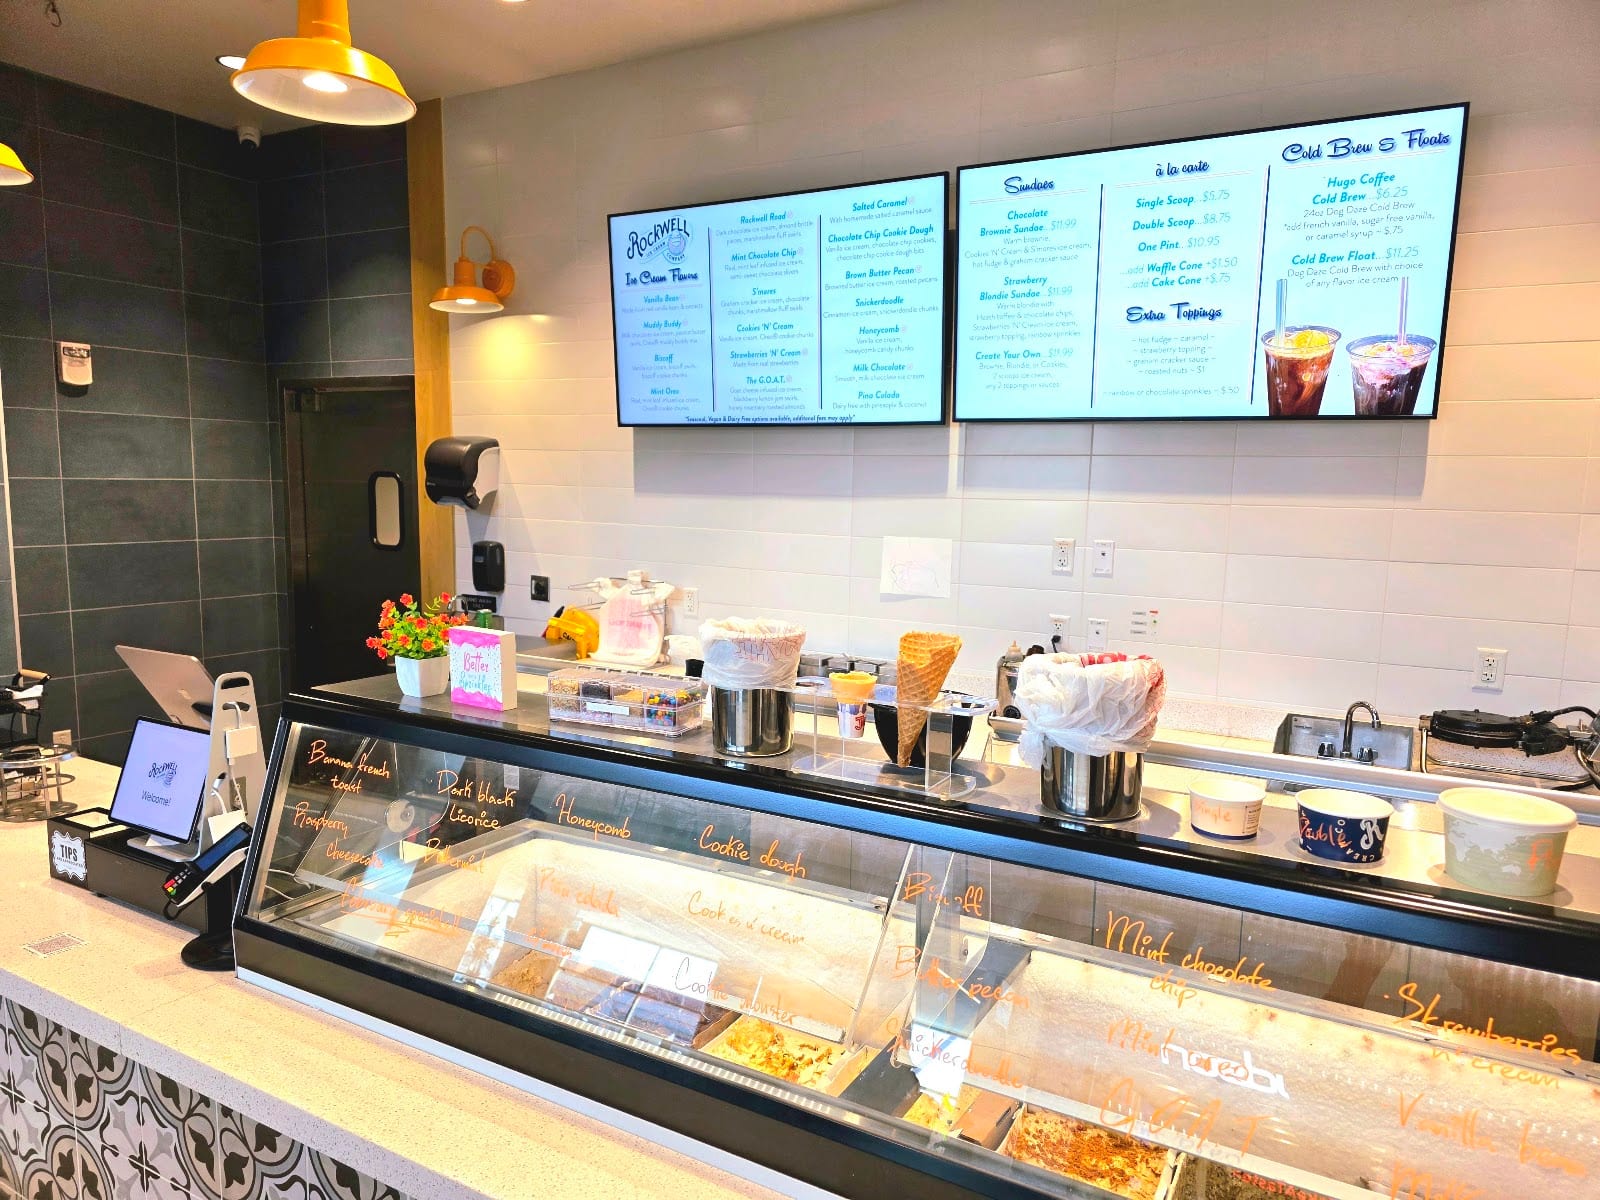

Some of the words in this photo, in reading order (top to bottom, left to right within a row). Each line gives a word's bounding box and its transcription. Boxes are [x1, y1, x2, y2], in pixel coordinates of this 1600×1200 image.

[1281, 142, 1323, 162] Cold
[1326, 137, 1373, 158] Brew
[1400, 128, 1451, 149] Floats
[1166, 162, 1180, 176] la
[1181, 160, 1211, 174] carte
[1004, 176, 1055, 194] Sundaes
[1327, 177, 1356, 190] Hugo
[1360, 171, 1396, 187] Coffee
[852, 201, 875, 212] Salted
[876, 195, 908, 209] Caramel
[1135, 196, 1164, 210] Single
[1166, 194, 1195, 207] Scoop
[1312, 193, 1338, 206] Cold
[1339, 191, 1368, 203] Brew
[740, 213, 768, 225] Rockwell
[769, 210, 787, 222] Road
[1007, 208, 1049, 220] Chocolate
[1326, 207, 1344, 218] Dog
[1369, 202, 1390, 212] Cold
[1393, 201, 1416, 210] Brew
[1132, 218, 1165, 231] Double
[1166, 217, 1195, 229] Scoop
[1303, 220, 1329, 229] french
[1360, 217, 1383, 226] sugar
[1385, 213, 1403, 222] free
[828, 232, 863, 243] Chocolate
[864, 229, 881, 242] Chip
[882, 226, 908, 238] Cookie
[909, 223, 934, 236] Dough
[980, 225, 1012, 237] Brownie
[1013, 223, 1044, 234] Sundae
[1305, 234, 1314, 242] or
[1317, 230, 1349, 239] caramel
[1350, 230, 1373, 240] syrup
[626, 217, 690, 260] ROCKWELL
[1137, 241, 1158, 252] One
[1159, 240, 1180, 250] Pint
[731, 253, 746, 262] Mint
[747, 250, 780, 260] Chocolate
[781, 248, 797, 259] Chip
[1291, 253, 1317, 265] Cold
[1318, 252, 1344, 264] Brew
[1347, 250, 1375, 262] Float
[639, 270, 667, 285] Cream
[668, 267, 699, 282] Flavors
[845, 270, 867, 280] Brown
[868, 268, 891, 278] Butter
[893, 266, 915, 276] Pecan
[1147, 261, 1177, 276] Waffle
[1178, 260, 1204, 271] Cone
[1288, 269, 1305, 279] Dog
[1329, 265, 1349, 275] Cold
[1352, 264, 1372, 273] Brew
[1375, 263, 1393, 271] with
[1395, 262, 1424, 271] choice
[1003, 276, 1048, 287] Strawberry
[1151, 276, 1176, 288] Cake
[1177, 275, 1202, 286] Cone
[1305, 280, 1315, 288] of
[1316, 280, 1330, 289] any
[1332, 278, 1355, 287] flavor
[1373, 276, 1399, 284] cream
[752, 287, 777, 296] S'mores
[979, 290, 1009, 301] Blondie
[1010, 288, 1041, 299] Sundae
[855, 296, 904, 307] Snickerdoodle
[1126, 306, 1167, 322] Extra
[1169, 301, 1222, 321] Toppings
[736, 323, 760, 332] Cookies
[772, 321, 794, 331] Cream
[859, 324, 900, 337] Honeycomb
[730, 350, 768, 359] Strawberries
[780, 348, 801, 357] Cream
[975, 351, 1001, 361] Create
[1003, 350, 1021, 360] Your
[1022, 349, 1041, 359] Own
[853, 363, 869, 373] Milk
[870, 362, 906, 372] Chocolate
[746, 375, 757, 385] The
[875, 390, 900, 400] Colada
[464, 652, 489, 673] Better
[308, 740, 353, 778] Banana
[355, 754, 390, 780] french
[330, 778, 362, 796] toast
[436, 769, 472, 800] Dark
[477, 781, 517, 809] black
[142, 790, 172, 807] Welcome!
[293, 801, 350, 840] Raspberry
[555, 793, 632, 841] Honeycomb
[60, 844, 78, 862] TIPS
[698, 824, 751, 862] Cookie
[759, 839, 807, 880] dough
[1105, 911, 1169, 965] Mint
[1180, 948, 1277, 993] chocolate
[966, 982, 1030, 1011] pecan
[1150, 973, 1198, 1009] chip
[1393, 981, 1583, 1066] Strawberries
[1105, 1017, 1175, 1059] Mint
[1470, 1058, 1560, 1091] cream
